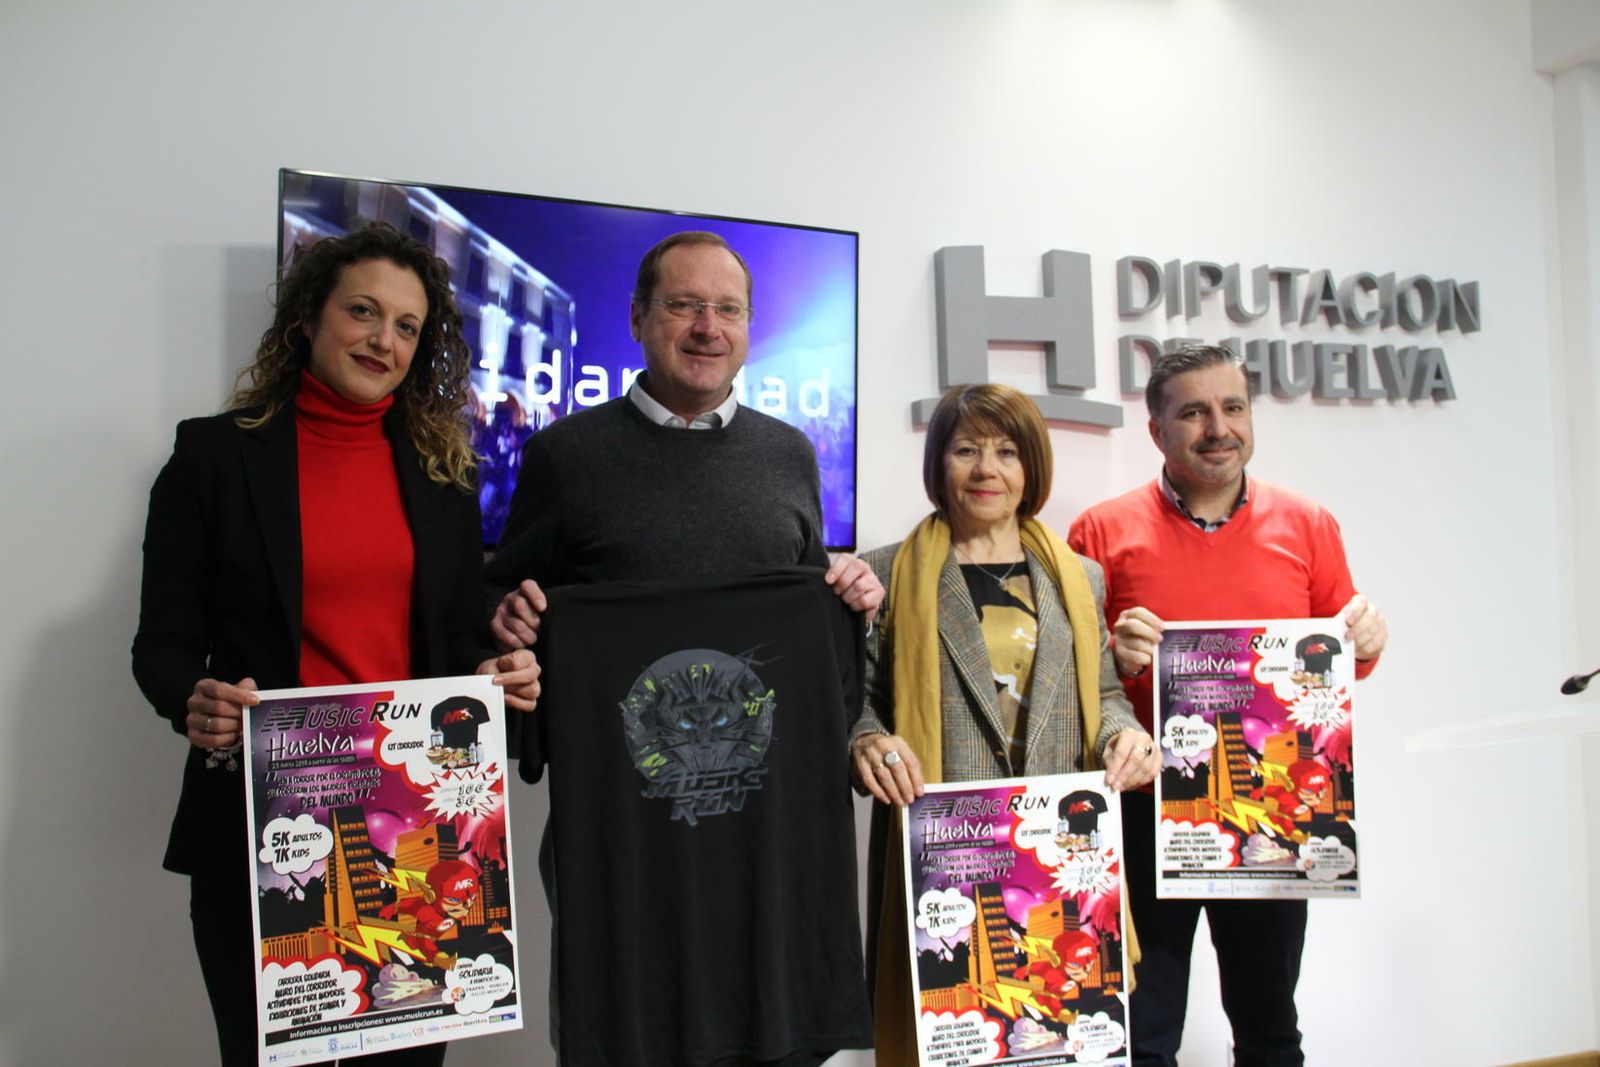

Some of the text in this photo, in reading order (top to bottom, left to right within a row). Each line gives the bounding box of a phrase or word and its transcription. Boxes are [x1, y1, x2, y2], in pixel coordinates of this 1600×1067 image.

[1117, 255, 1480, 333] DIPUTACION
[1118, 335, 1204, 394] D
[1247, 635, 1288, 650] RUN
[1169, 655, 1236, 674] Huelva
[369, 702, 422, 722] RUN
[265, 732, 355, 761] Huelva
[301, 796, 318, 808] DEL
[1007, 794, 1050, 812] RUN
[272, 831, 323, 847] 5K ADULTOS
[920, 820, 994, 843] Huelva
[274, 848, 310, 863] 1K KIDS
[926, 902, 940, 915] 5K
[278, 970, 331, 987] CARRERA SOLIDARIA
[459, 966, 493, 979] SOLIDARIA
[340, 998, 347, 1008] Y
[290, 1024, 331, 1039] Información
[385, 1008, 444, 1023] www.musicrun.es
